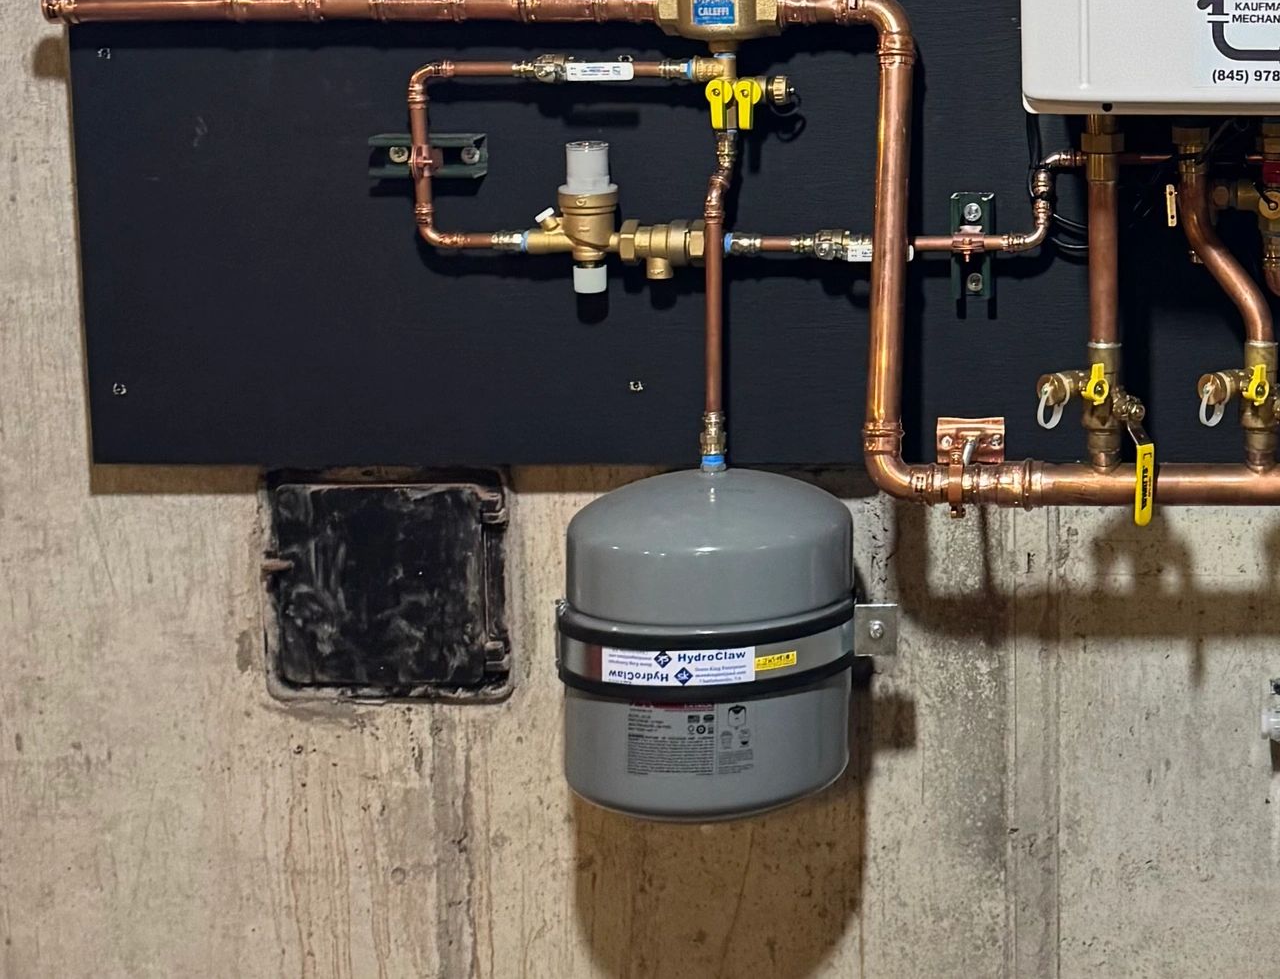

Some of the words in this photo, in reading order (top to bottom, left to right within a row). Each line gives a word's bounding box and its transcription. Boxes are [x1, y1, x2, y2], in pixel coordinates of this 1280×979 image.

[698, 7, 729, 16] CALEFFI
[1212, 69, 1249, 84] (845)
[678, 651, 746, 664] HydroClaw
[608, 670, 669, 682] HydroClaw
